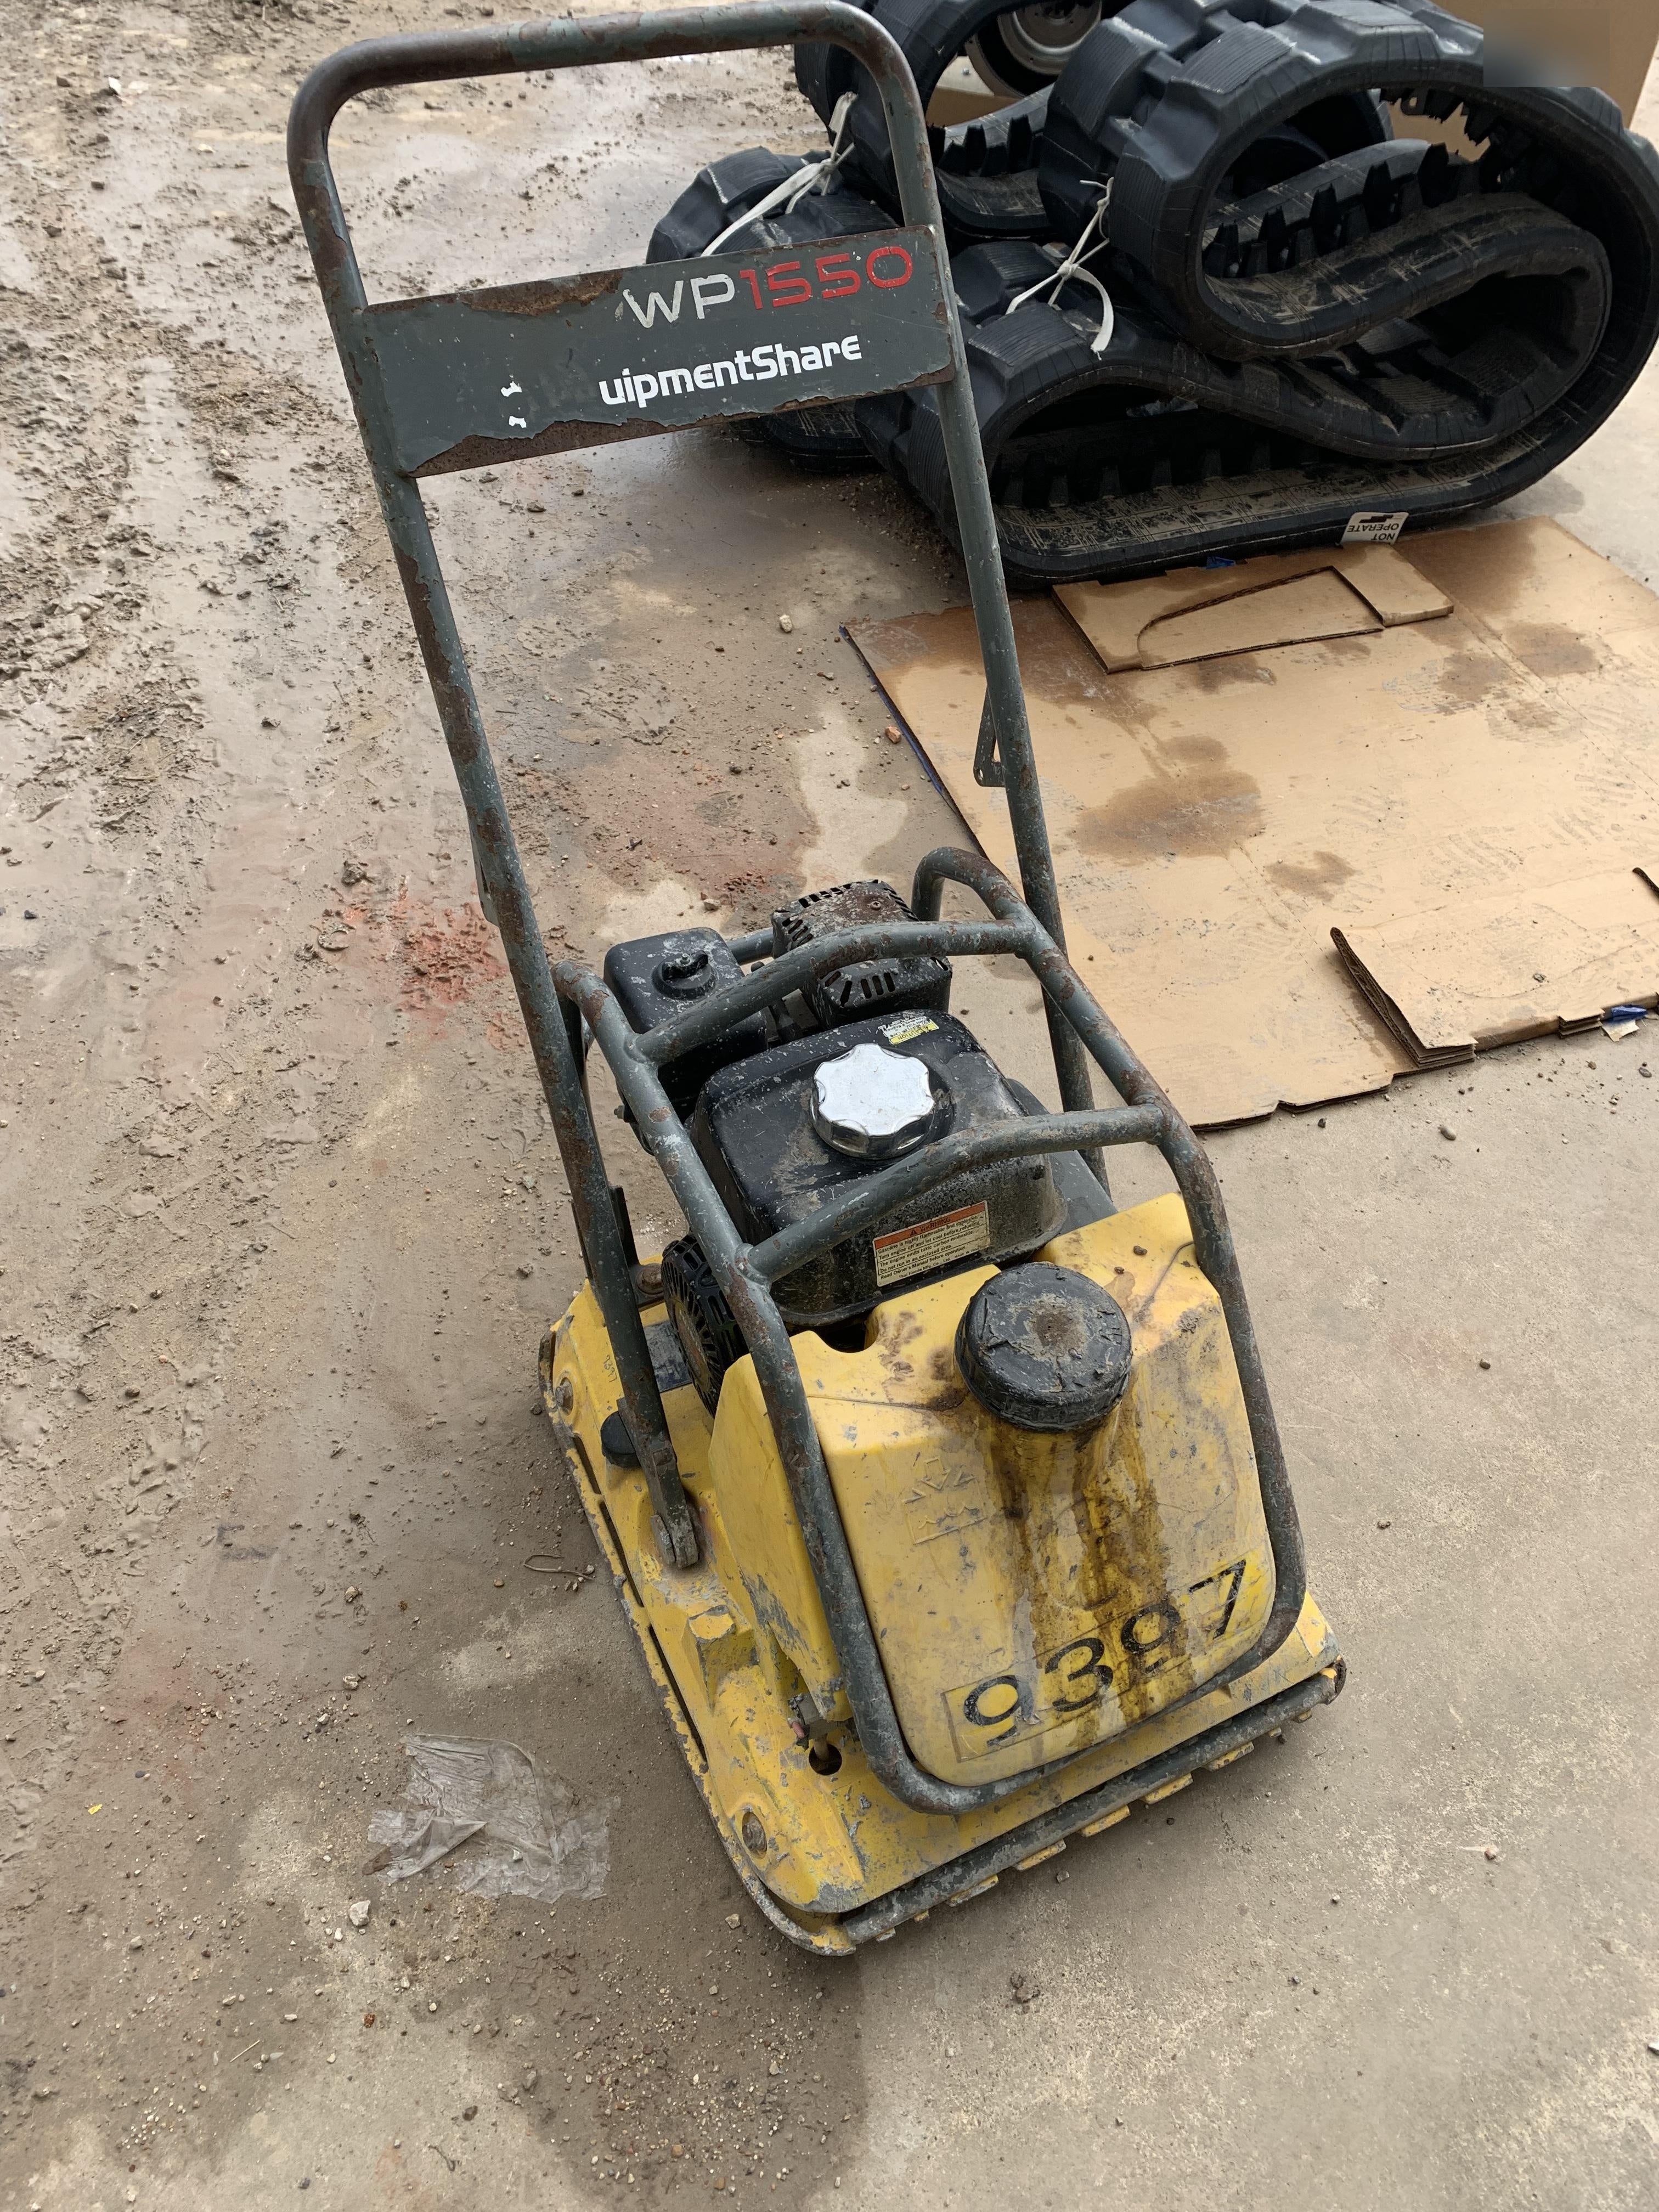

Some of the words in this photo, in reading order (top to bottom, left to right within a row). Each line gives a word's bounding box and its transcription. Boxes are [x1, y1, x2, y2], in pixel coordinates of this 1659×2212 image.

[622, 246, 913, 329] WP1550
[1347, 523, 1400, 532] OPERATE
[878, 1244, 899, 1254] Gasoline
[905, 1237, 919, 1245] highly
[920, 1227, 945, 1239] flammable
[890, 1248, 906, 1256] engine
[933, 1233, 943, 1241] cool
[944, 1228, 958, 1237] before
[890, 1255, 906, 1263] engine
[933, 1239, 950, 1248] carbon
[919, 1247, 940, 1260] enclosed
[881, 1272, 893, 1280] Read
[893, 1265, 911, 1275] Owner's
[912, 1259, 929, 1268] Manual
[929, 1254, 944, 1262] before
[963, 1559, 1246, 1747] 9397
